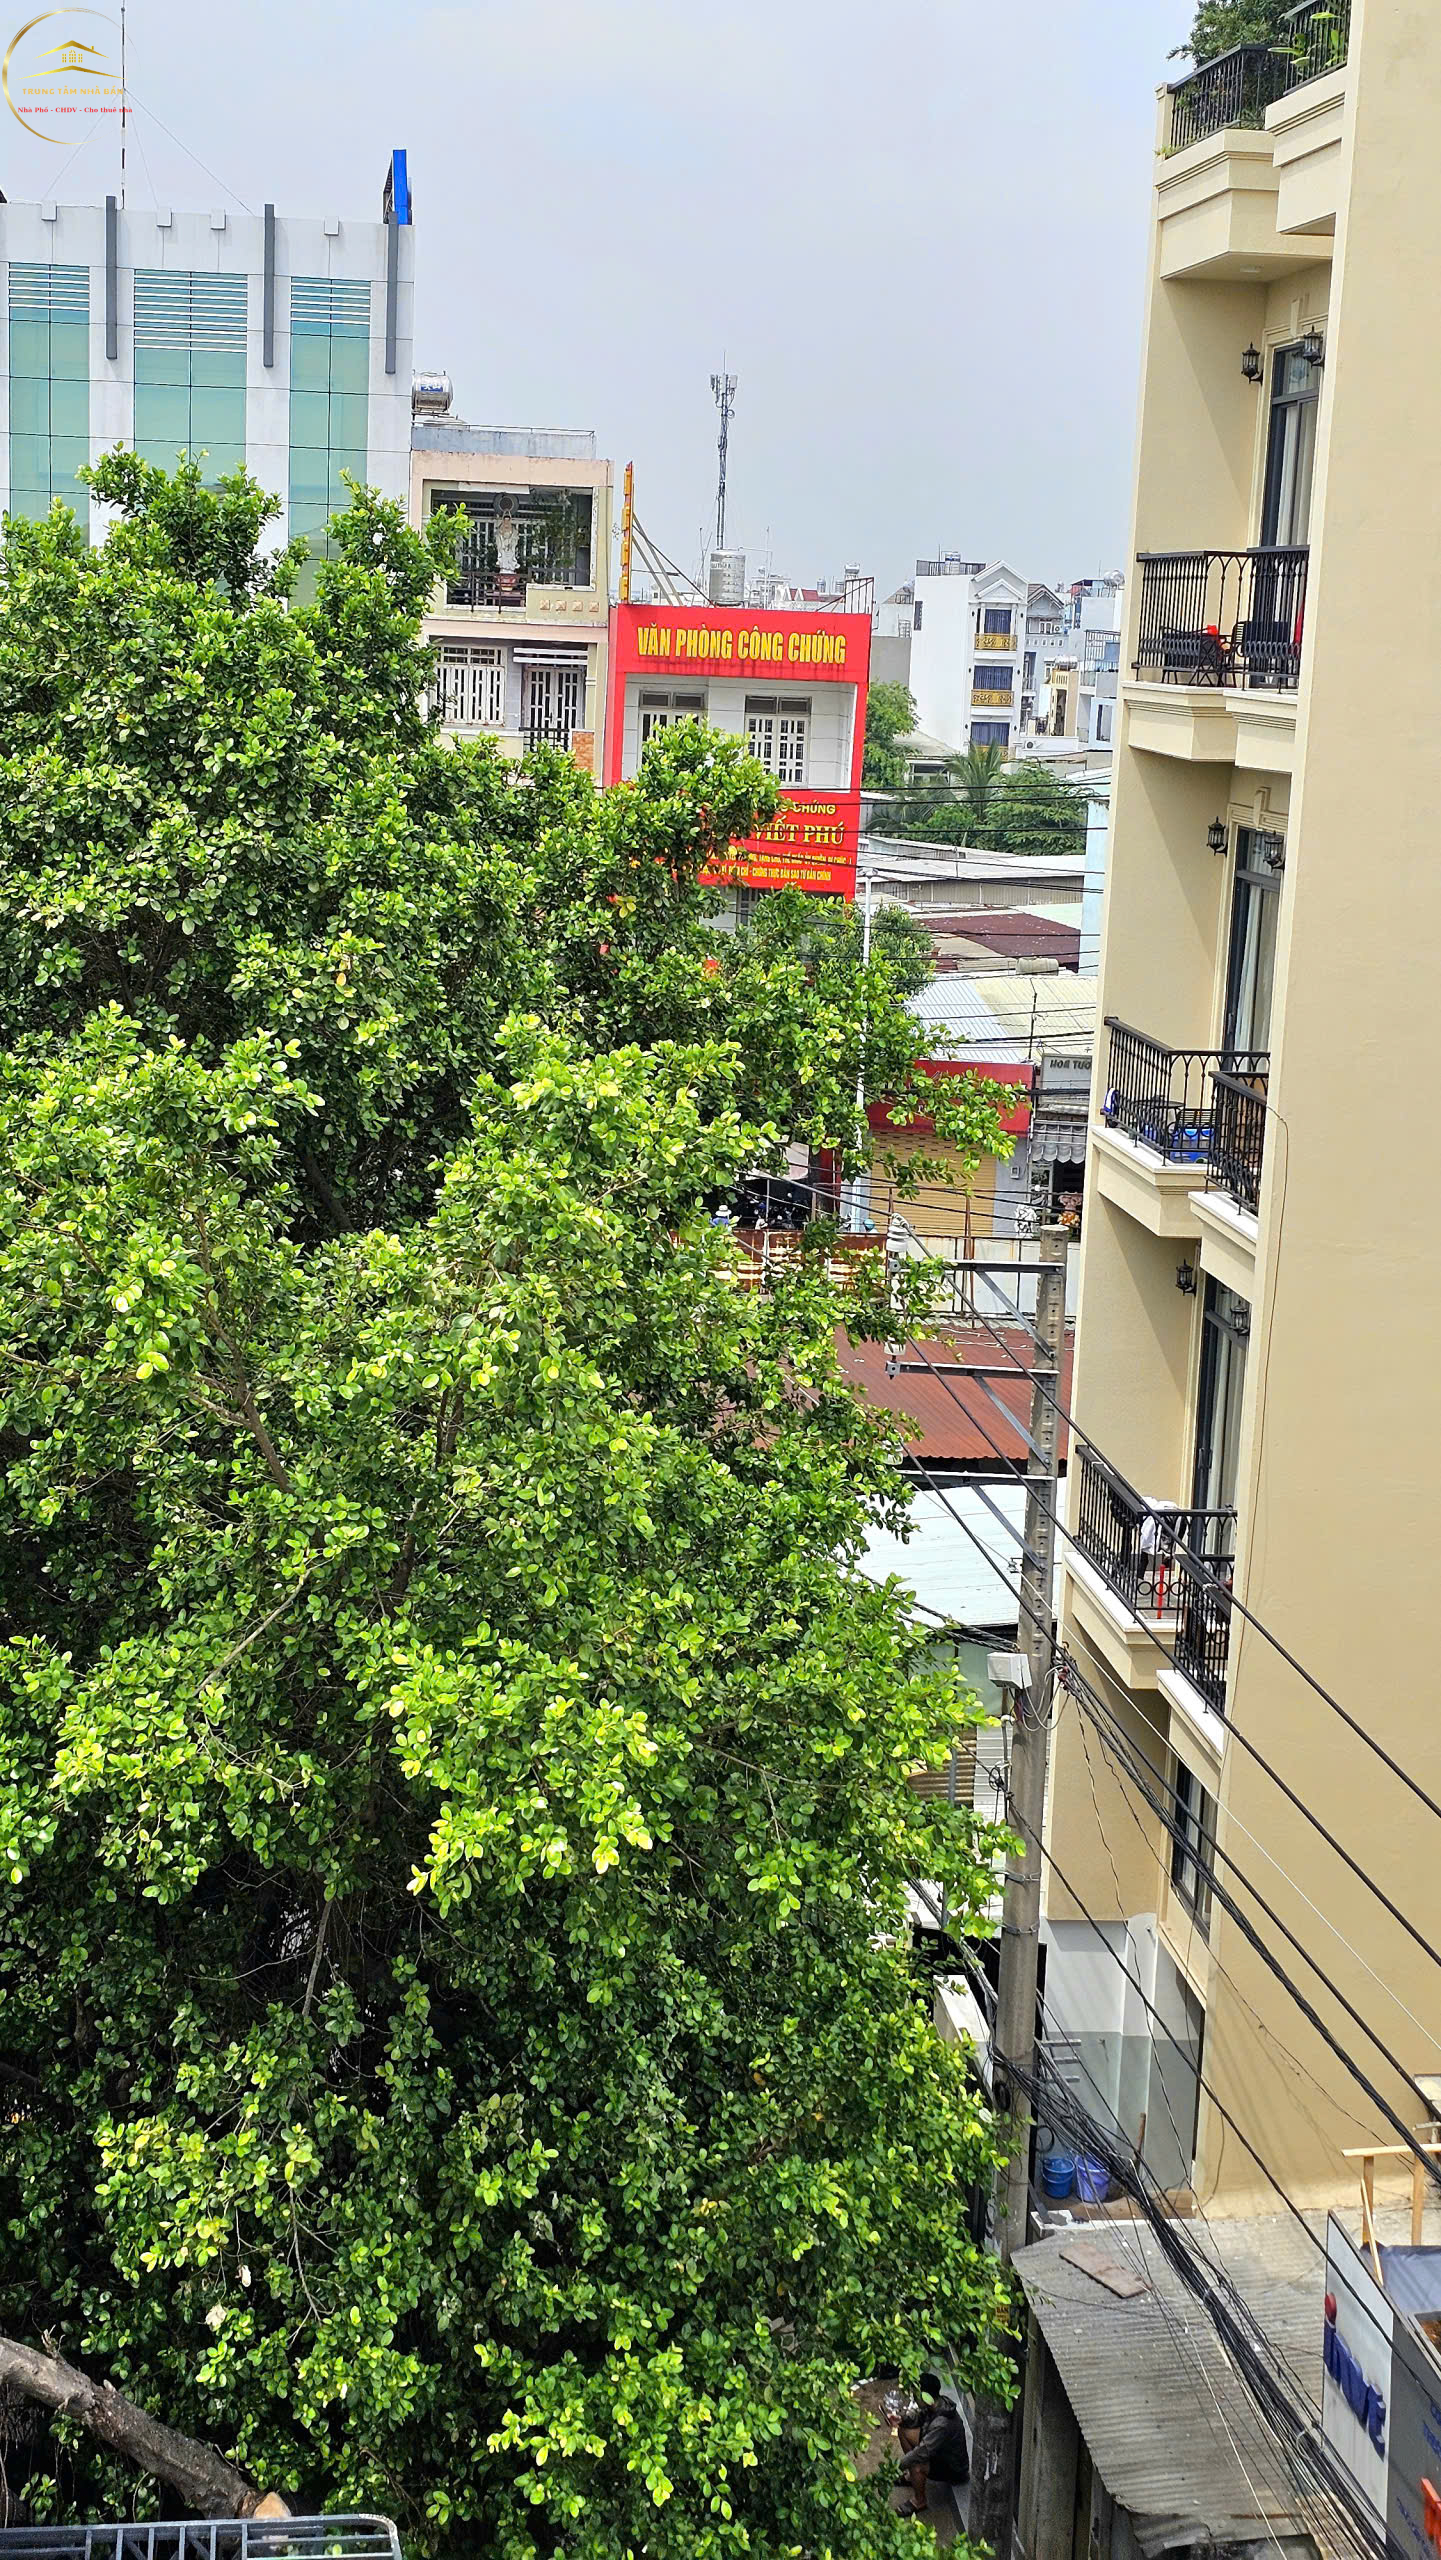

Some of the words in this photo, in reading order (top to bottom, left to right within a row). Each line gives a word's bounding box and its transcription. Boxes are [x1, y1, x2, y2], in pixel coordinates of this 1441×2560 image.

[637, 622, 671, 656] VĂN
[675, 624, 733, 660] PHÒNG
[737, 626, 784, 661] CÔNG
[788, 629, 846, 664] CHỨNG
[803, 821, 845, 845] PHÚ
